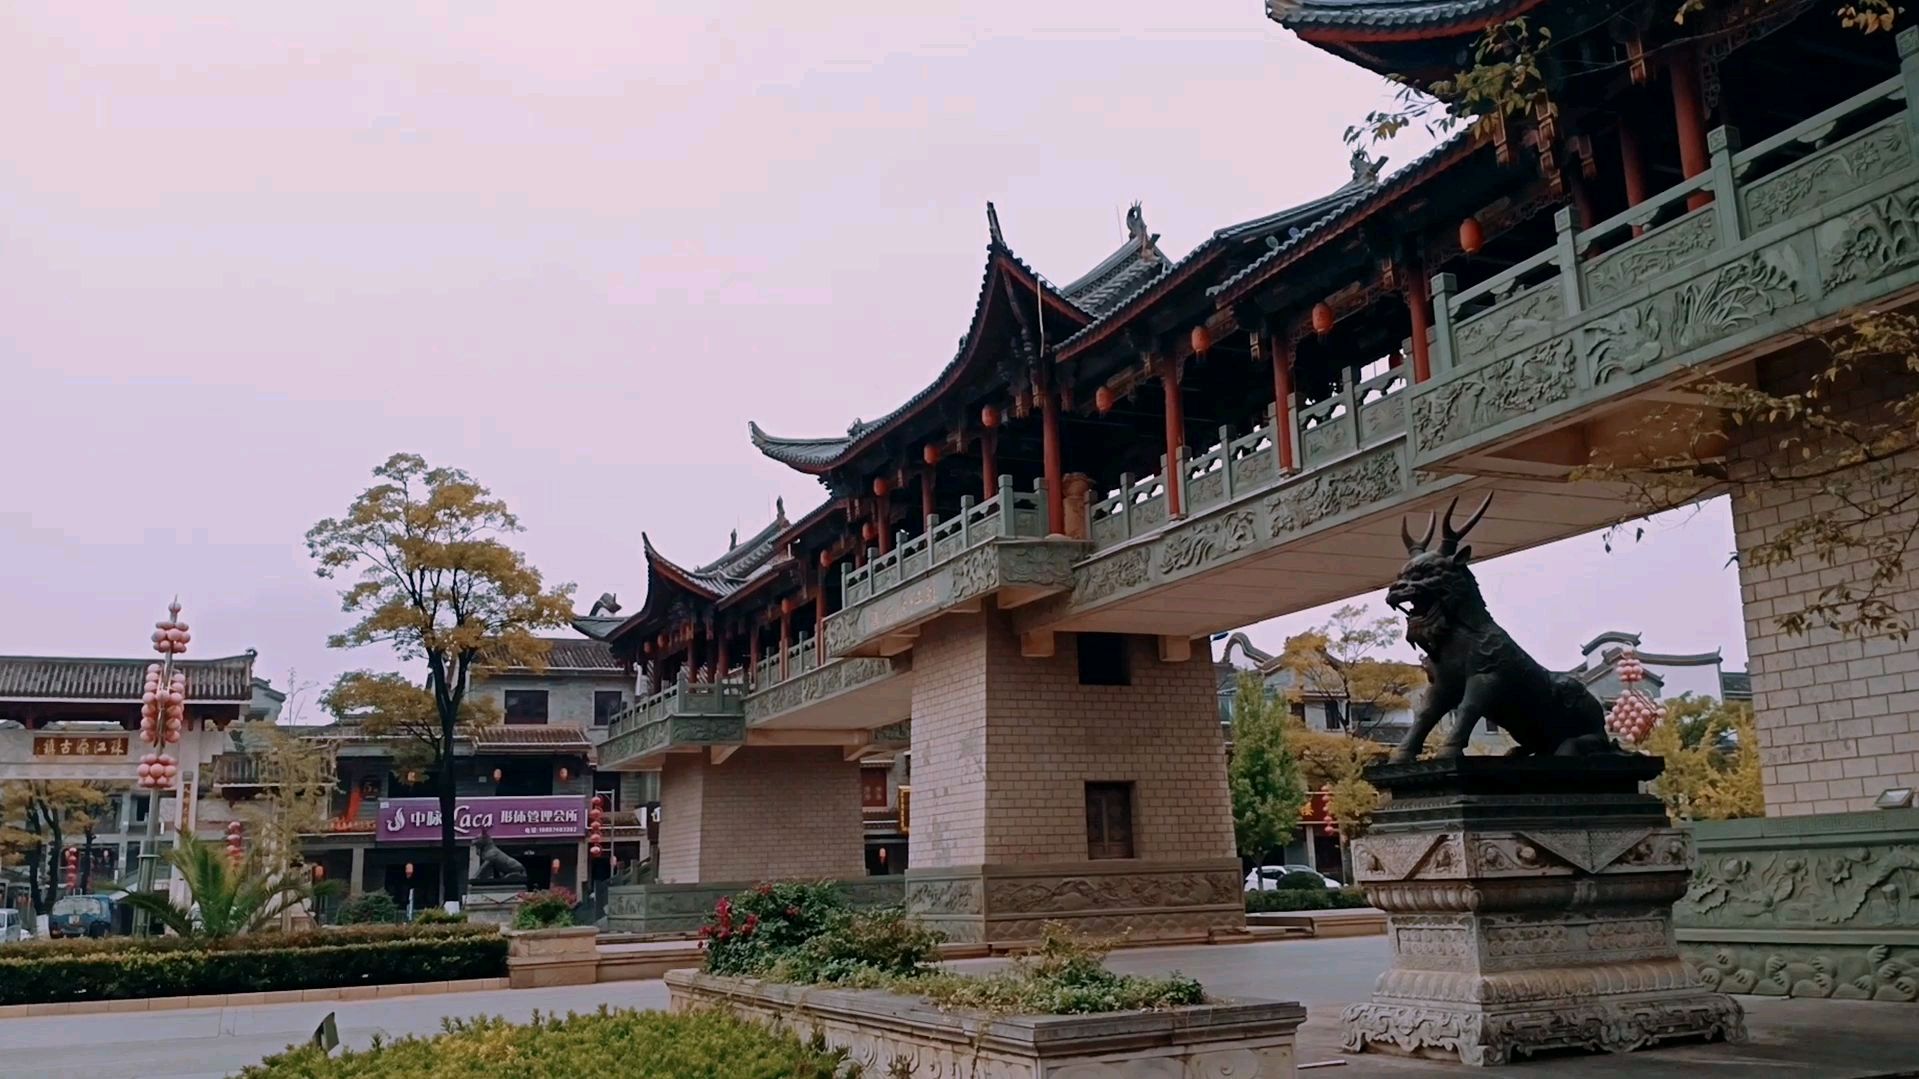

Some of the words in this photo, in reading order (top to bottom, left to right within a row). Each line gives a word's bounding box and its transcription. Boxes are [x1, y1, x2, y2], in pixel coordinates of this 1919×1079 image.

[411, 810, 442, 827] 中脉
[501, 809, 578, 824] 形体管理会所
